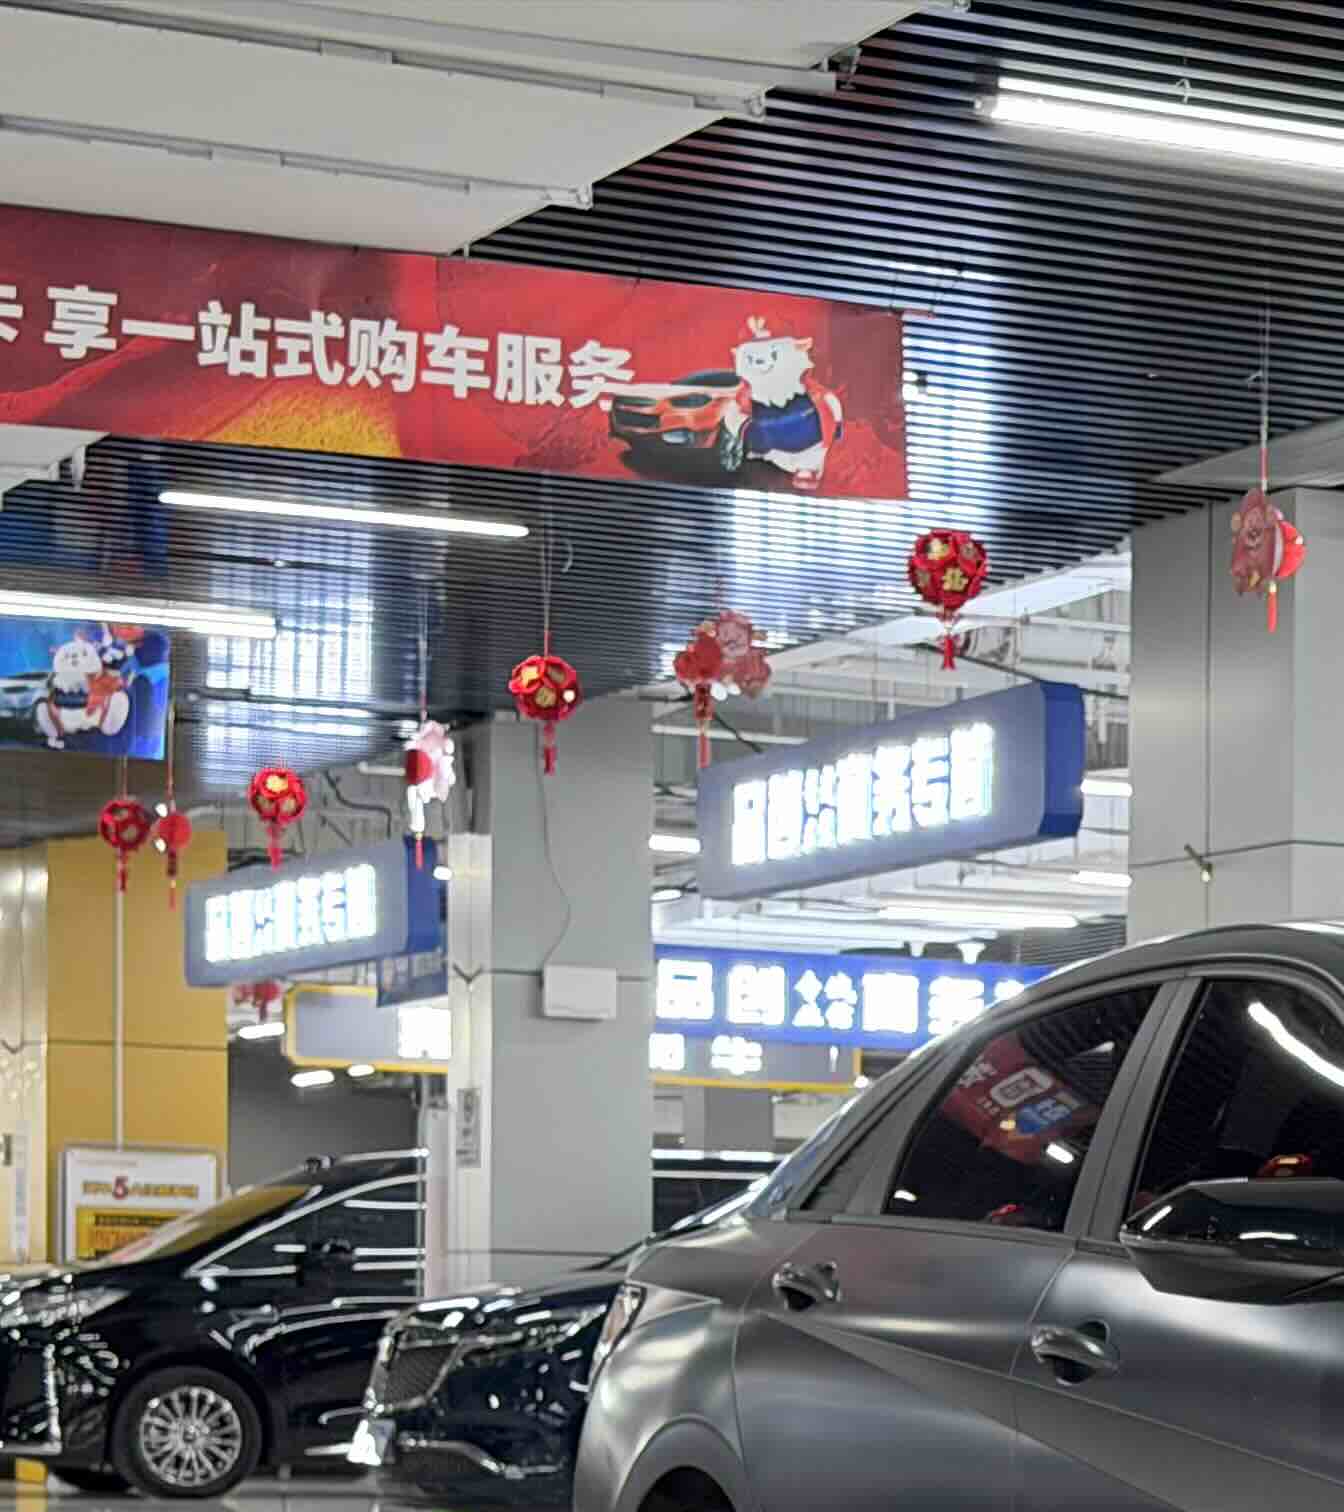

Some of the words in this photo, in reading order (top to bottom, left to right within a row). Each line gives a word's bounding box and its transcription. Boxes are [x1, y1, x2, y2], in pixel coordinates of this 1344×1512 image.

[43, 284, 635, 412] 享一站式购车服务
